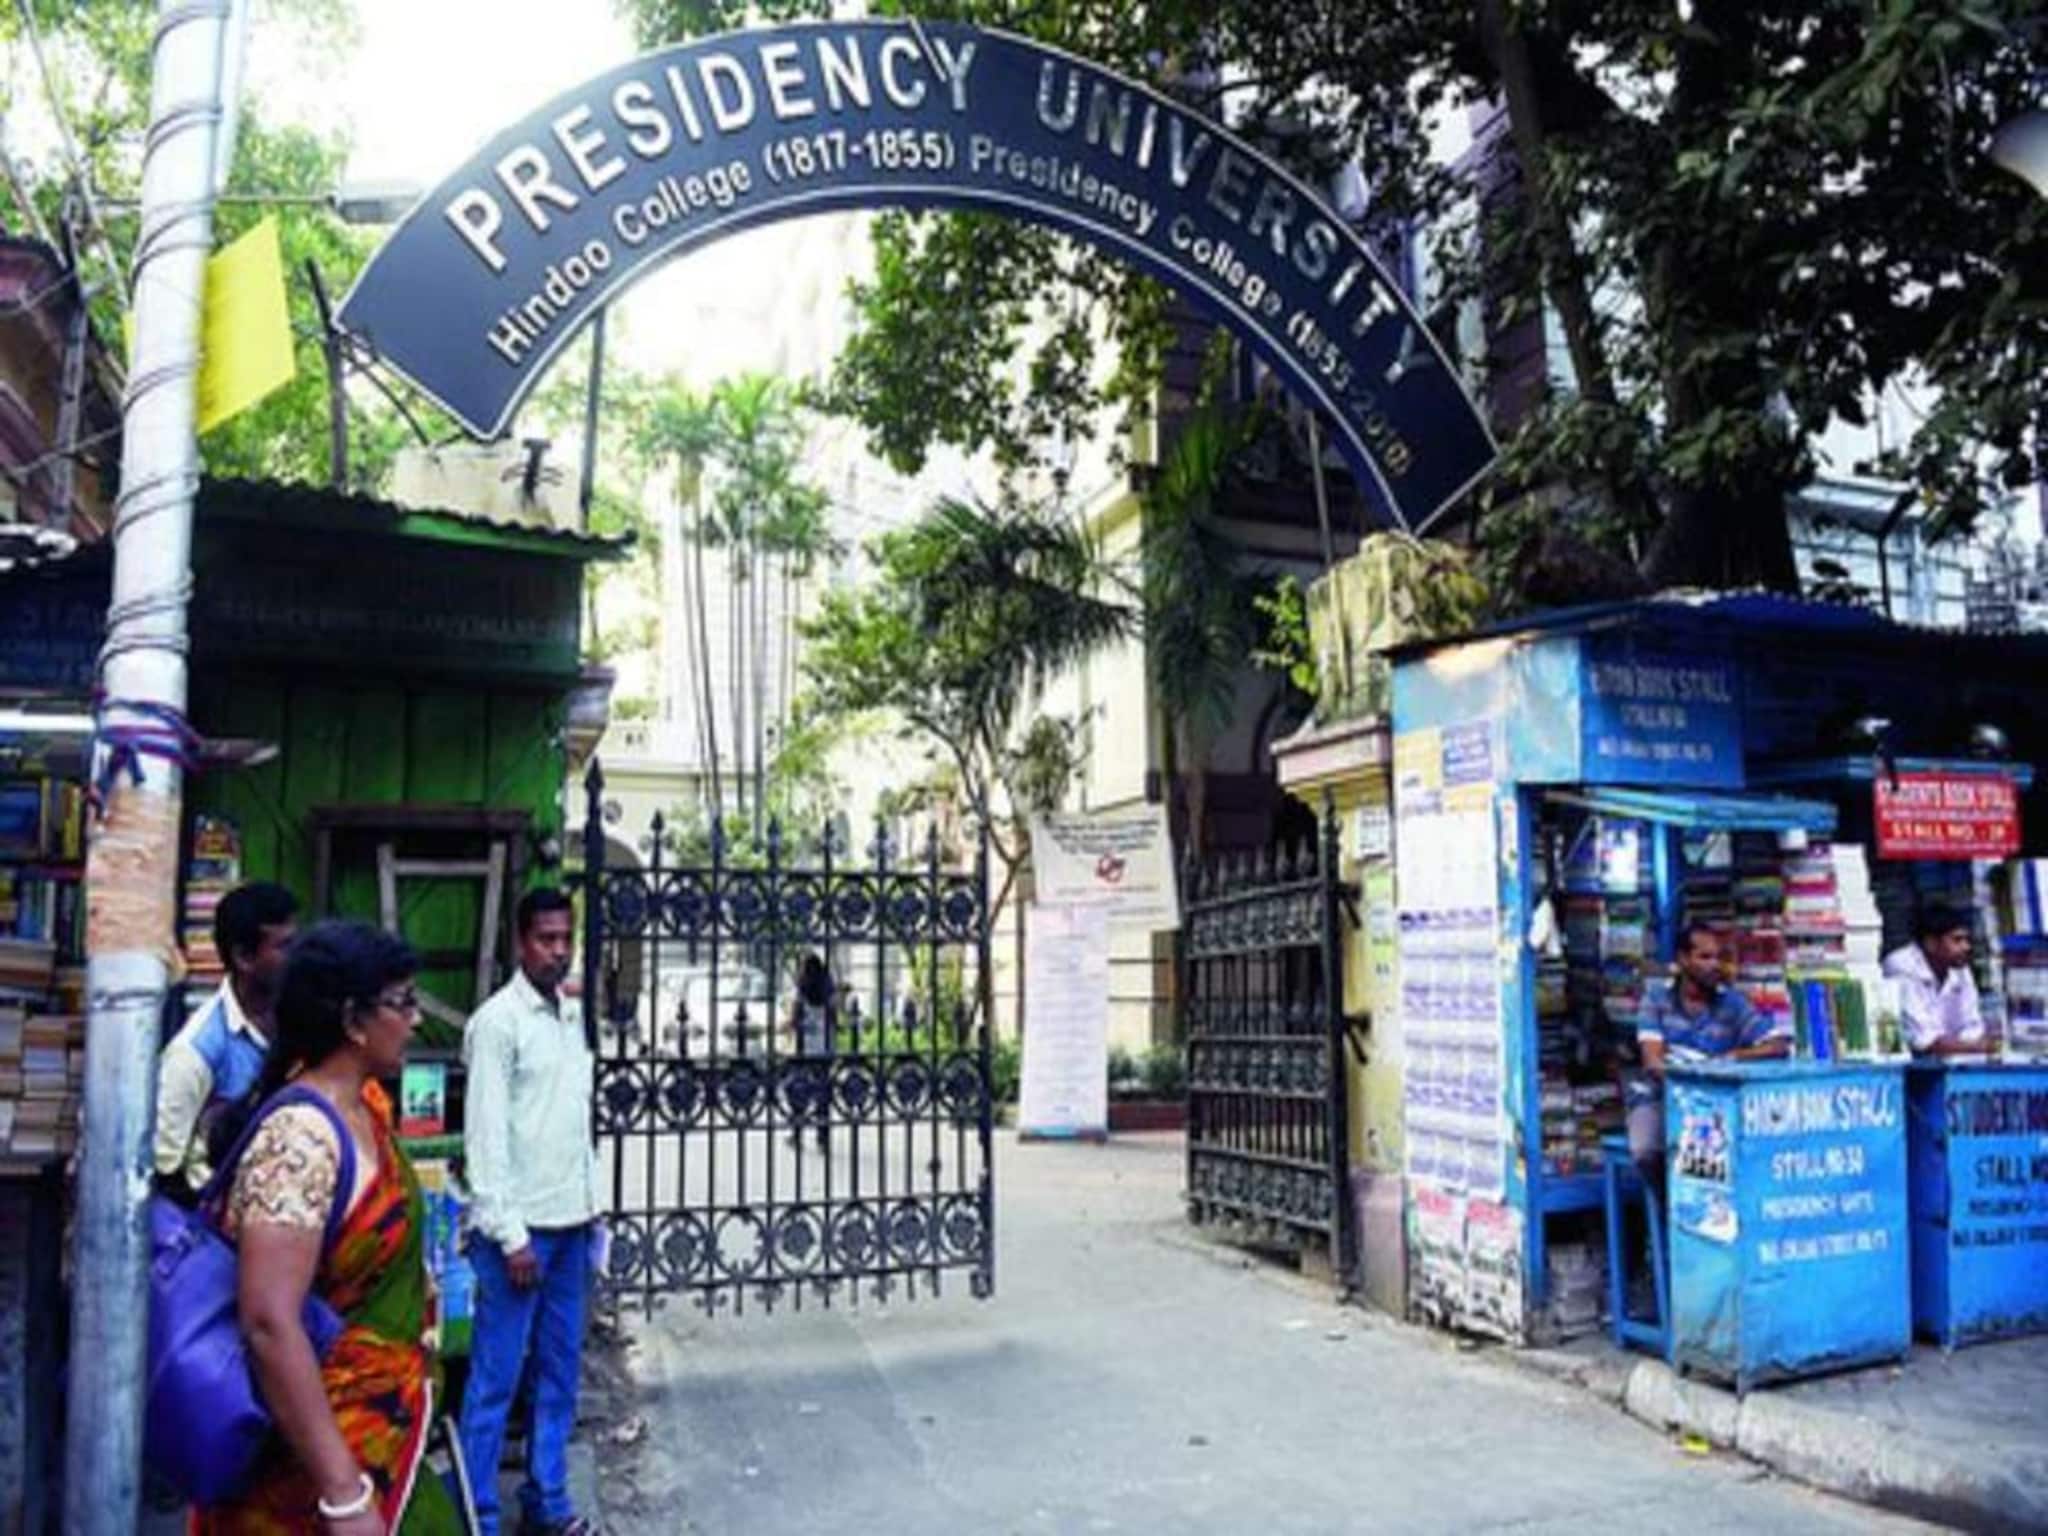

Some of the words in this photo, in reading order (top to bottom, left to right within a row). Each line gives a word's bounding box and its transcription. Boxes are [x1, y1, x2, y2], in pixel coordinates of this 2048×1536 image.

[444, 36, 977, 272] PRESIDENCY
[1037, 60, 1435, 383] UNIVERSITY
[486, 241, 612, 365] Hindoo
[613, 158, 753, 246] College
[763, 130, 955, 184] (1817-1855)
[969, 137, 1159, 235] Presidency
[1169, 211, 1283, 317] College
